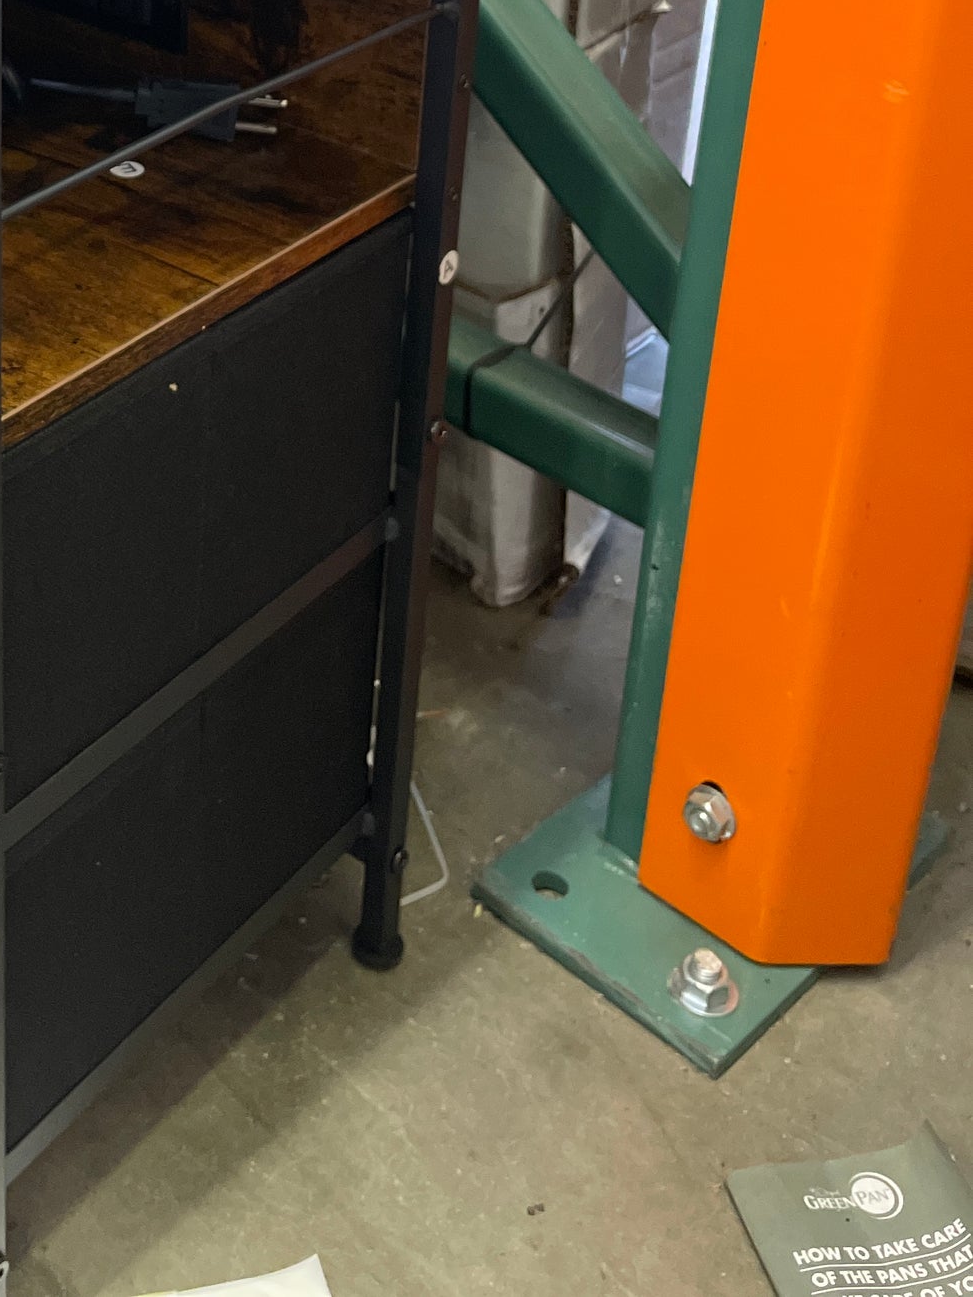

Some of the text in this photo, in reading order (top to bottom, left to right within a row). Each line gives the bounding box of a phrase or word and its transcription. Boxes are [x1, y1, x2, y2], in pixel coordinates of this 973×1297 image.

[793, 1218, 966, 1265] HOW TO TAKE CARE
[811, 1243, 973, 1287] OF THE PANS THAT
